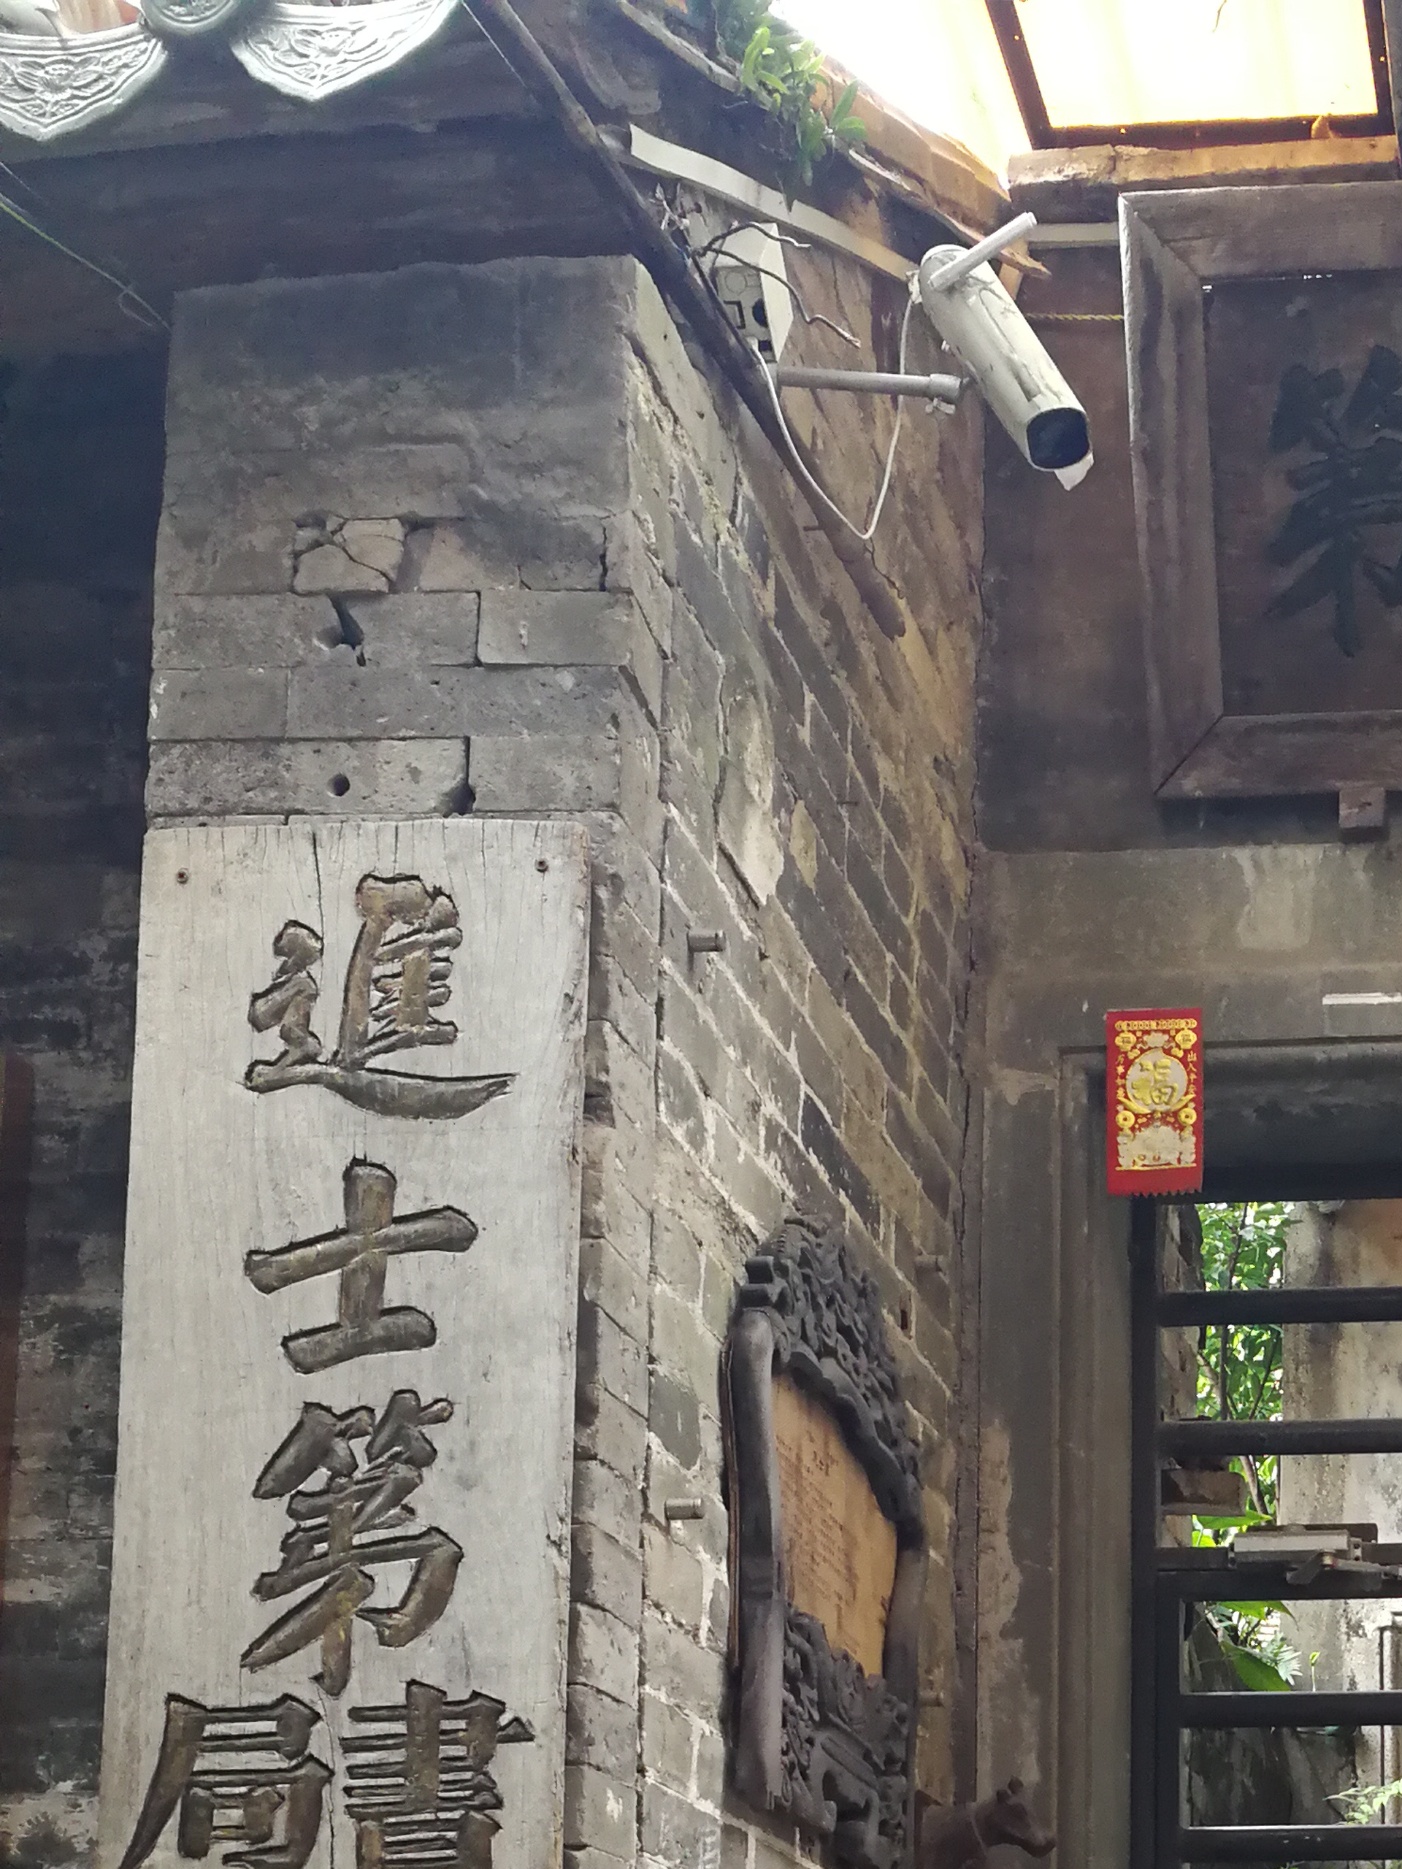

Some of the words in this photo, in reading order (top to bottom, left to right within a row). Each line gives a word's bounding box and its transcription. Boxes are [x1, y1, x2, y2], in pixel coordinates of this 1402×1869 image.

[242, 873, 516, 1696] 進士第
[1131, 1059, 1179, 1106] 福
